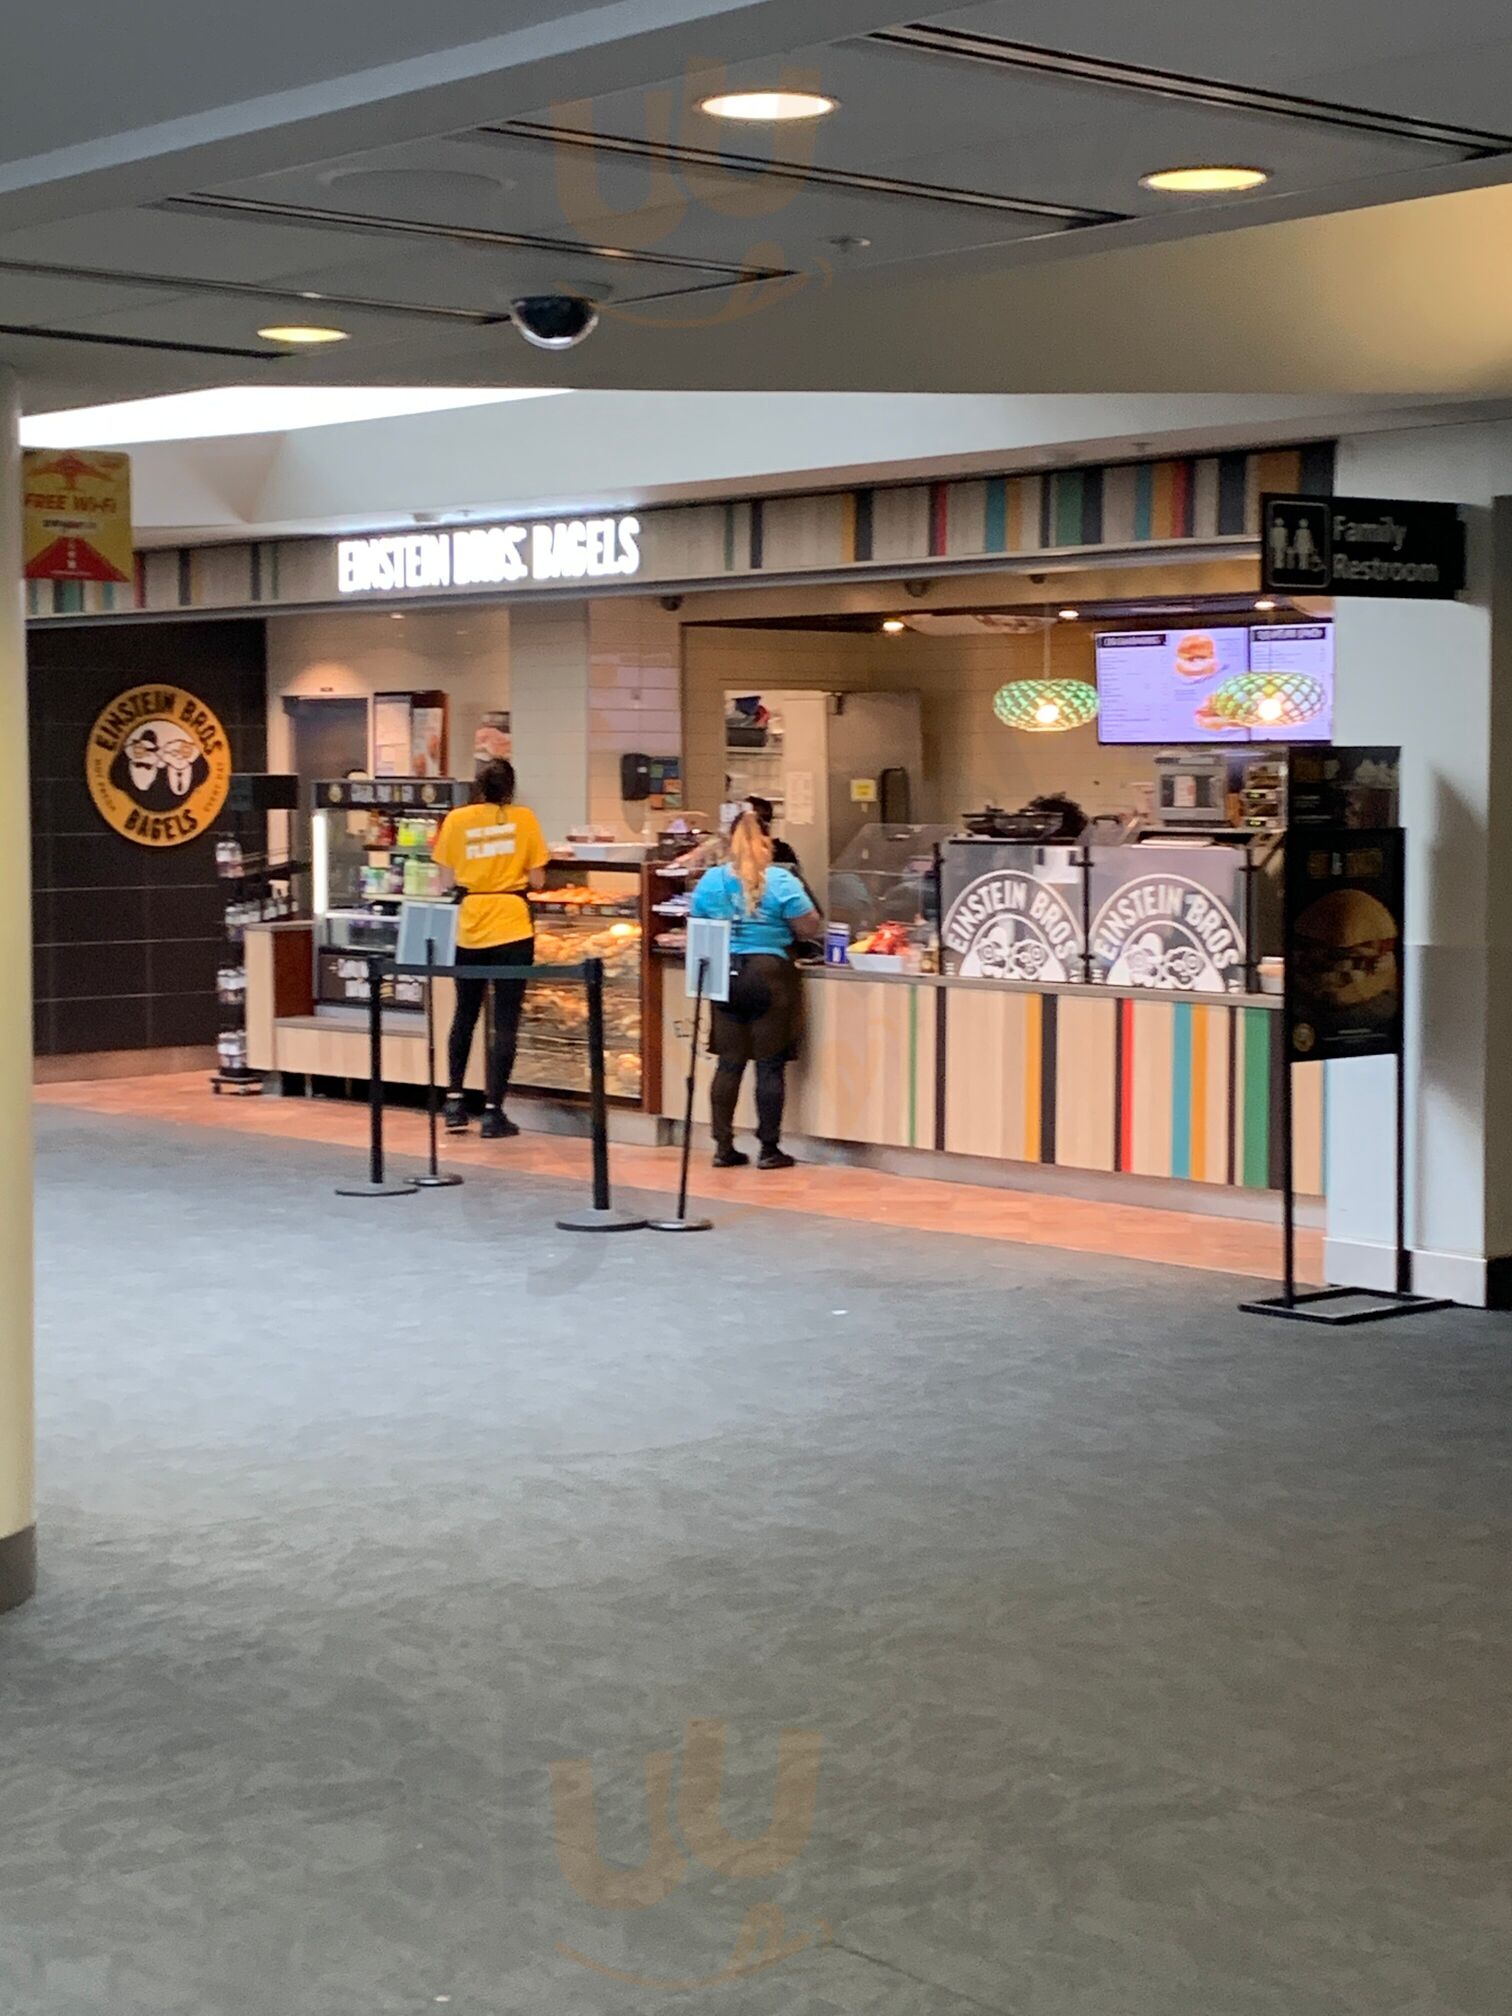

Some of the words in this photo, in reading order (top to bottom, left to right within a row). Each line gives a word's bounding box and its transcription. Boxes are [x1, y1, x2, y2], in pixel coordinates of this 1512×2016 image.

[338, 533, 450, 592] EINSTEIN
[531, 516, 641, 580] BAGELS
[1332, 514, 1408, 552] Family
[1332, 552, 1441, 582] Restroom
[95, 690, 177, 752] EINSTEIN
[180, 700, 224, 757] BROS
[123, 808, 199, 841] BAGELS
[945, 880, 1028, 955] EINSTEIN
[1029, 890, 1077, 960] BROS
[1093, 884, 1185, 962] EINSTEIN
[1183, 893, 1240, 970] BROS
